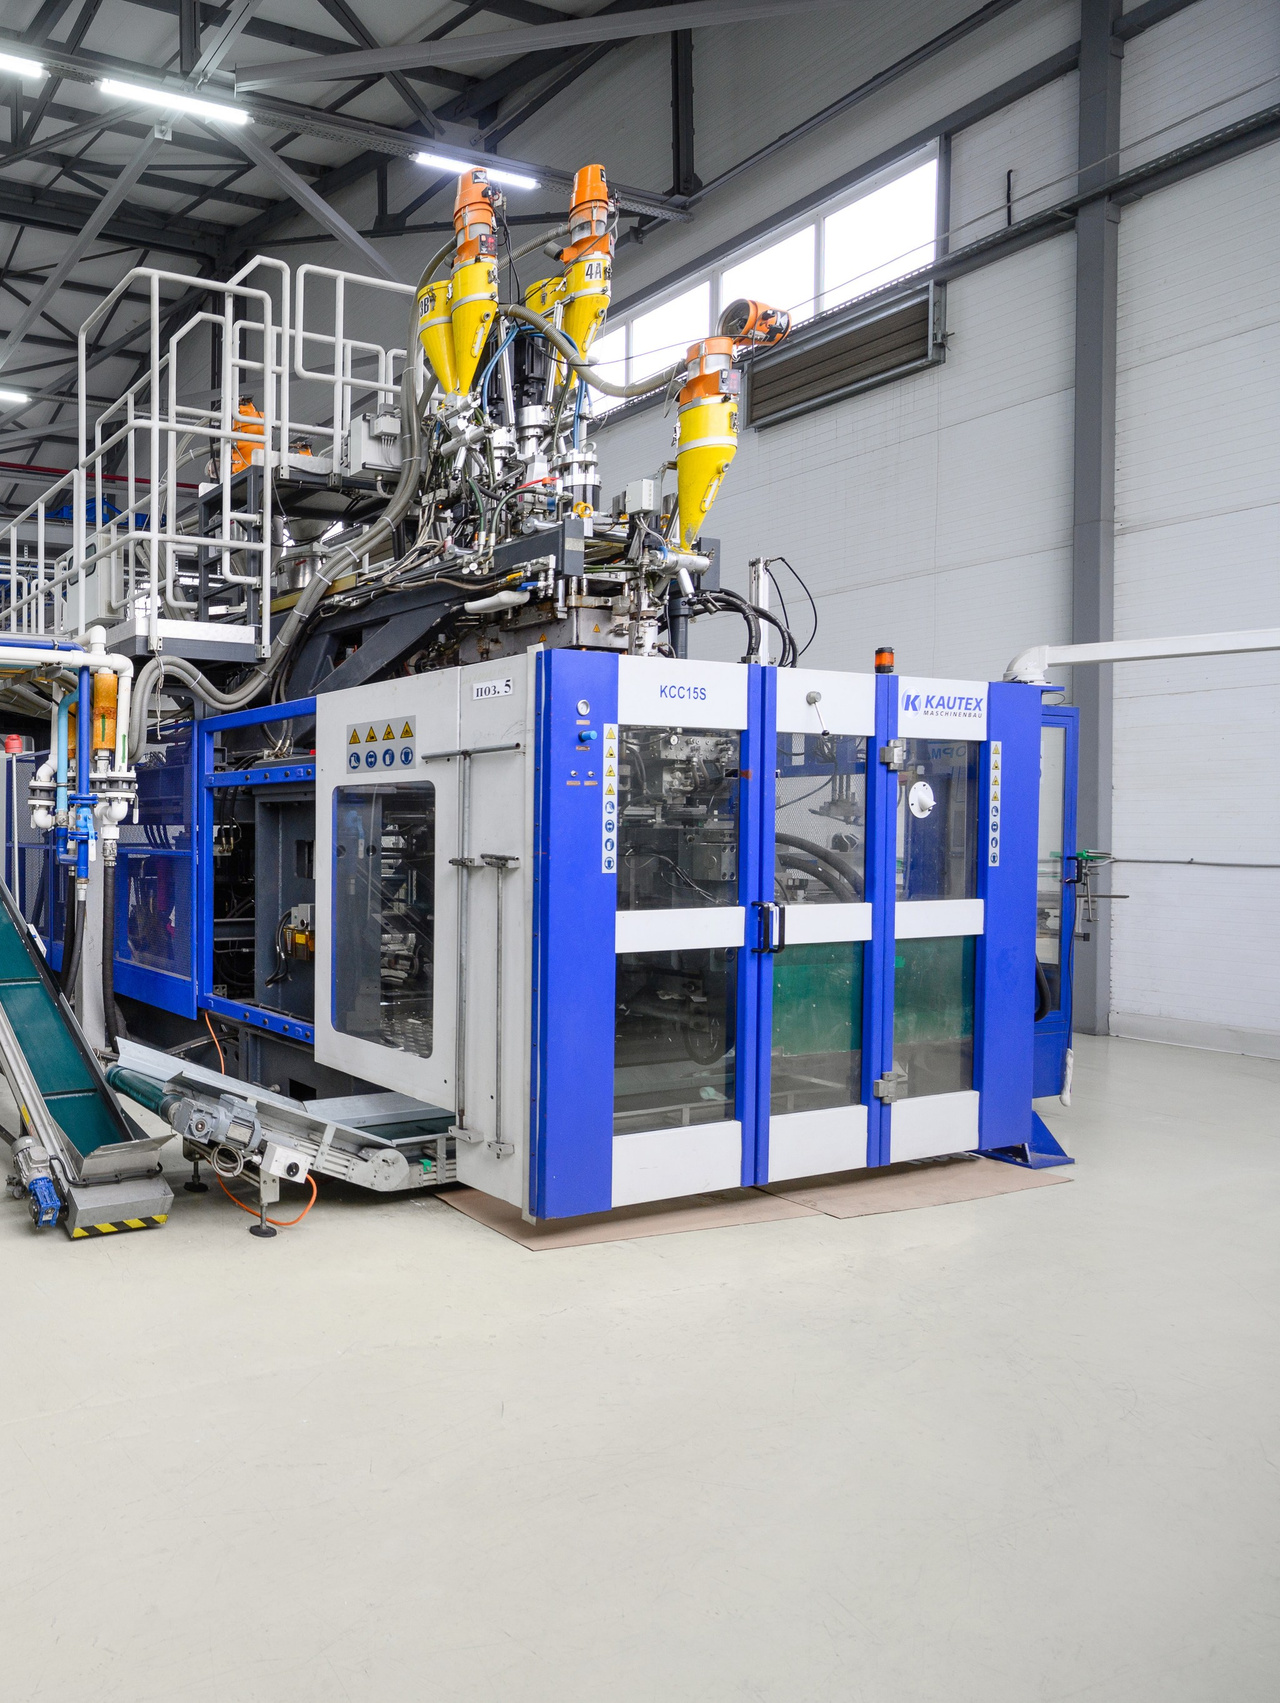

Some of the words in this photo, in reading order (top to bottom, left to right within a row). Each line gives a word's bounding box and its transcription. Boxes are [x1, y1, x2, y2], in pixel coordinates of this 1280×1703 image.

[585, 262, 602, 280] 4A
[475, 685, 500, 698] поз.
[504, 679, 511, 694] 5
[659, 684, 707, 701] KCC15S
[925, 695, 983, 711] KAUTEX
[923, 710, 982, 718] MASCHINENBAU
